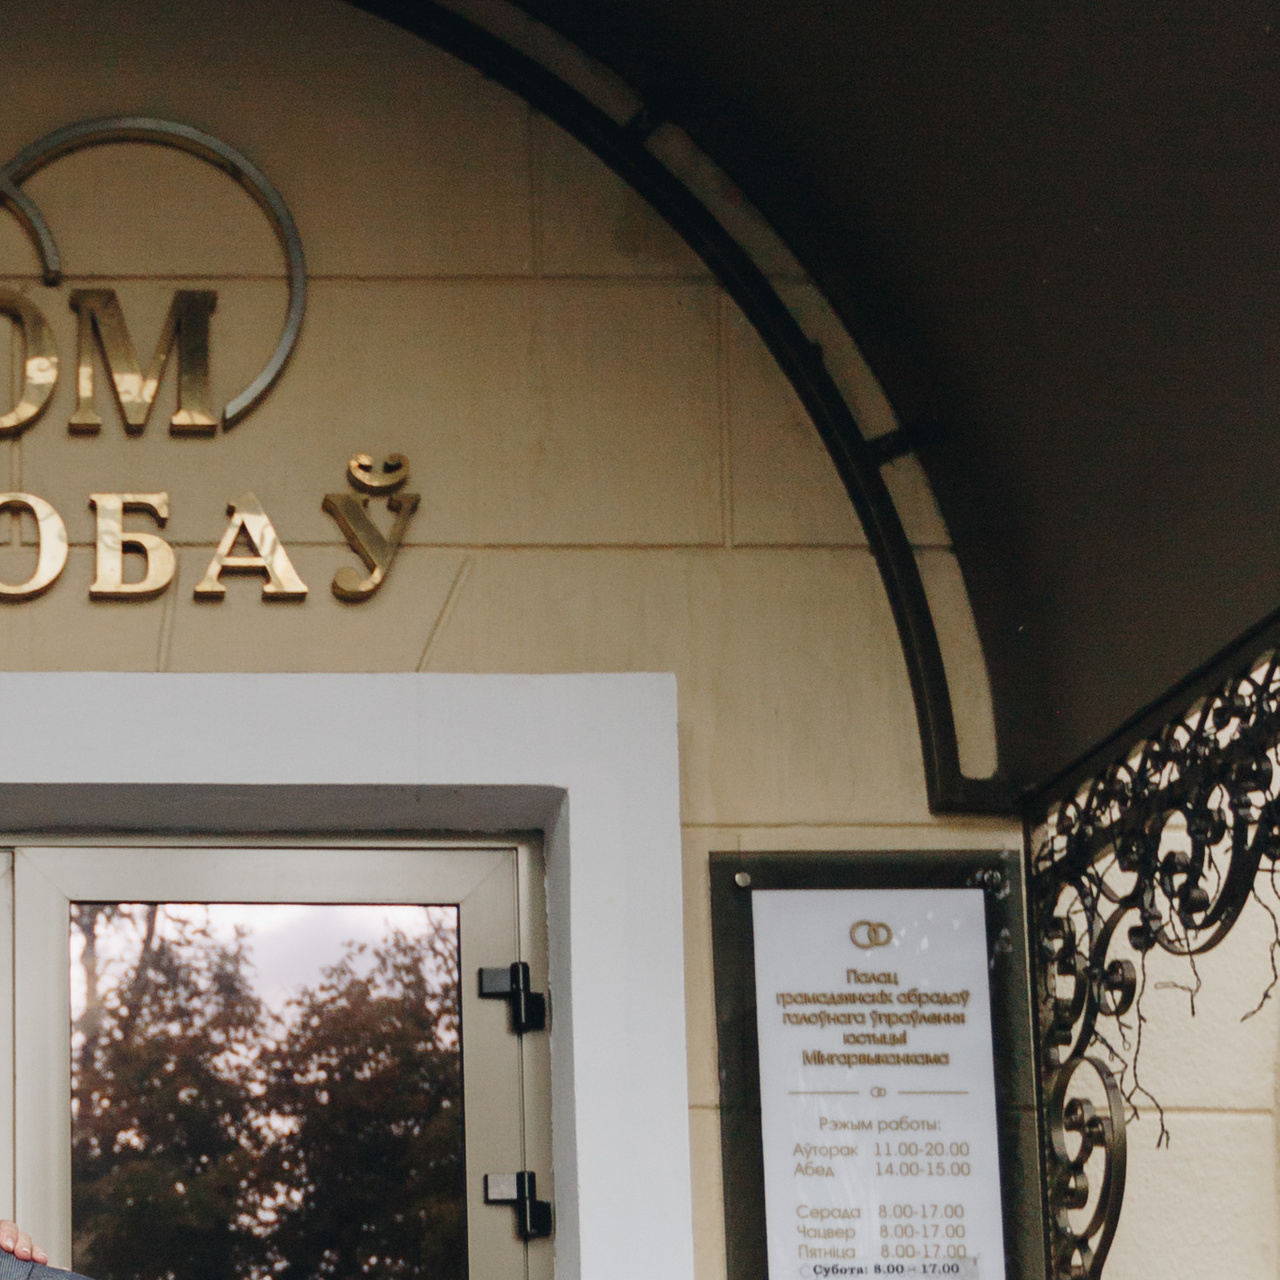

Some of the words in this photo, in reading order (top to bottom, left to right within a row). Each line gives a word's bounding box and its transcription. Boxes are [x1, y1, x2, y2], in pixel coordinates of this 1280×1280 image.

[846, 967, 899, 987] Палац
[782, 1010, 866, 1028] галоўнага
[869, 1009, 966, 1028] ўпраўлення
[843, 1030, 907, 1047] юстыцыі
[802, 1049, 950, 1068] Мінгарвыканкама
[819, 1116, 873, 1131] Рэжым
[877, 1116, 942, 1134] работы:
[793, 1142, 858, 1160] Аўторак
[874, 1142, 970, 1157] 11.00-20.00
[794, 1161, 835, 1177] Абед
[875, 1162, 971, 1177] 14.00-15.00
[796, 1204, 861, 1221] Серада
[878, 1204, 965, 1219] 8.00-17.00
[796, 1224, 856, 1241] Чацвер
[879, 1223, 966, 1239] 8.00-17.00
[798, 1243, 856, 1260] Пятніца
[880, 1243, 968, 1259] 8.00-17.00
[812, 1263, 868, 1277] Субота:
[873, 1263, 905, 1275] 8.00
[921, 1263, 960, 1275] 17.00
